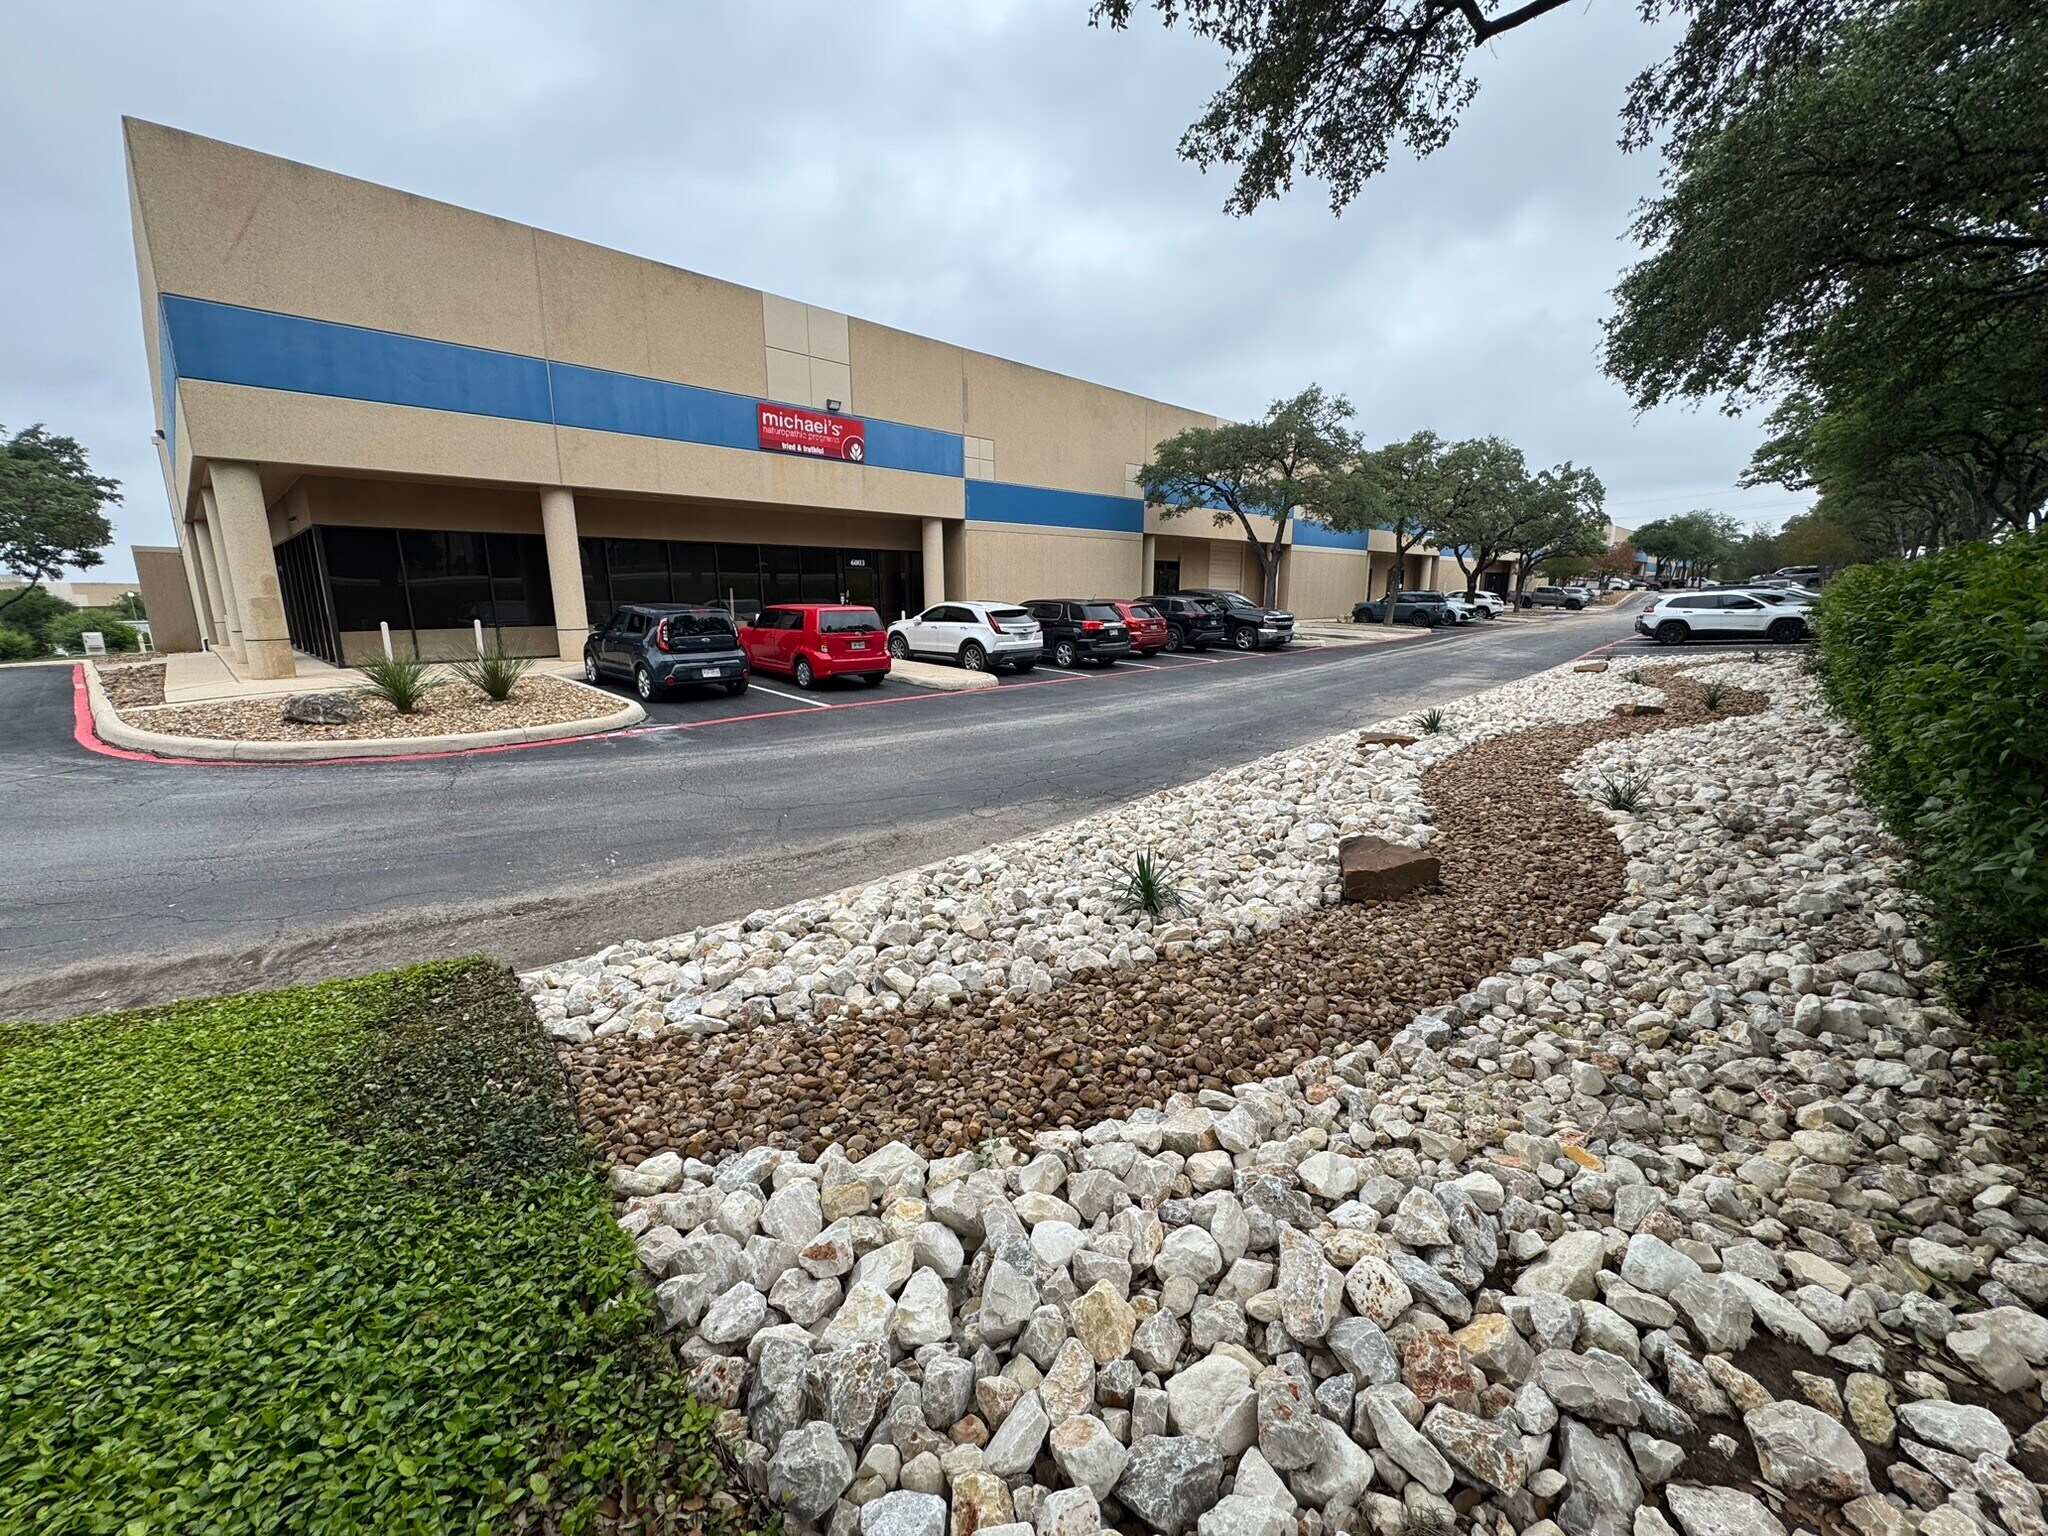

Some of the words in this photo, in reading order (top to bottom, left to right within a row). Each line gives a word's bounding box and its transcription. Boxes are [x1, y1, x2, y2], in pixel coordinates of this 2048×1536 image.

[762, 411, 840, 436] michael's
[762, 426, 807, 439] naturopathic
[781, 442, 796, 451] tried
[797, 443, 802, 452] &
